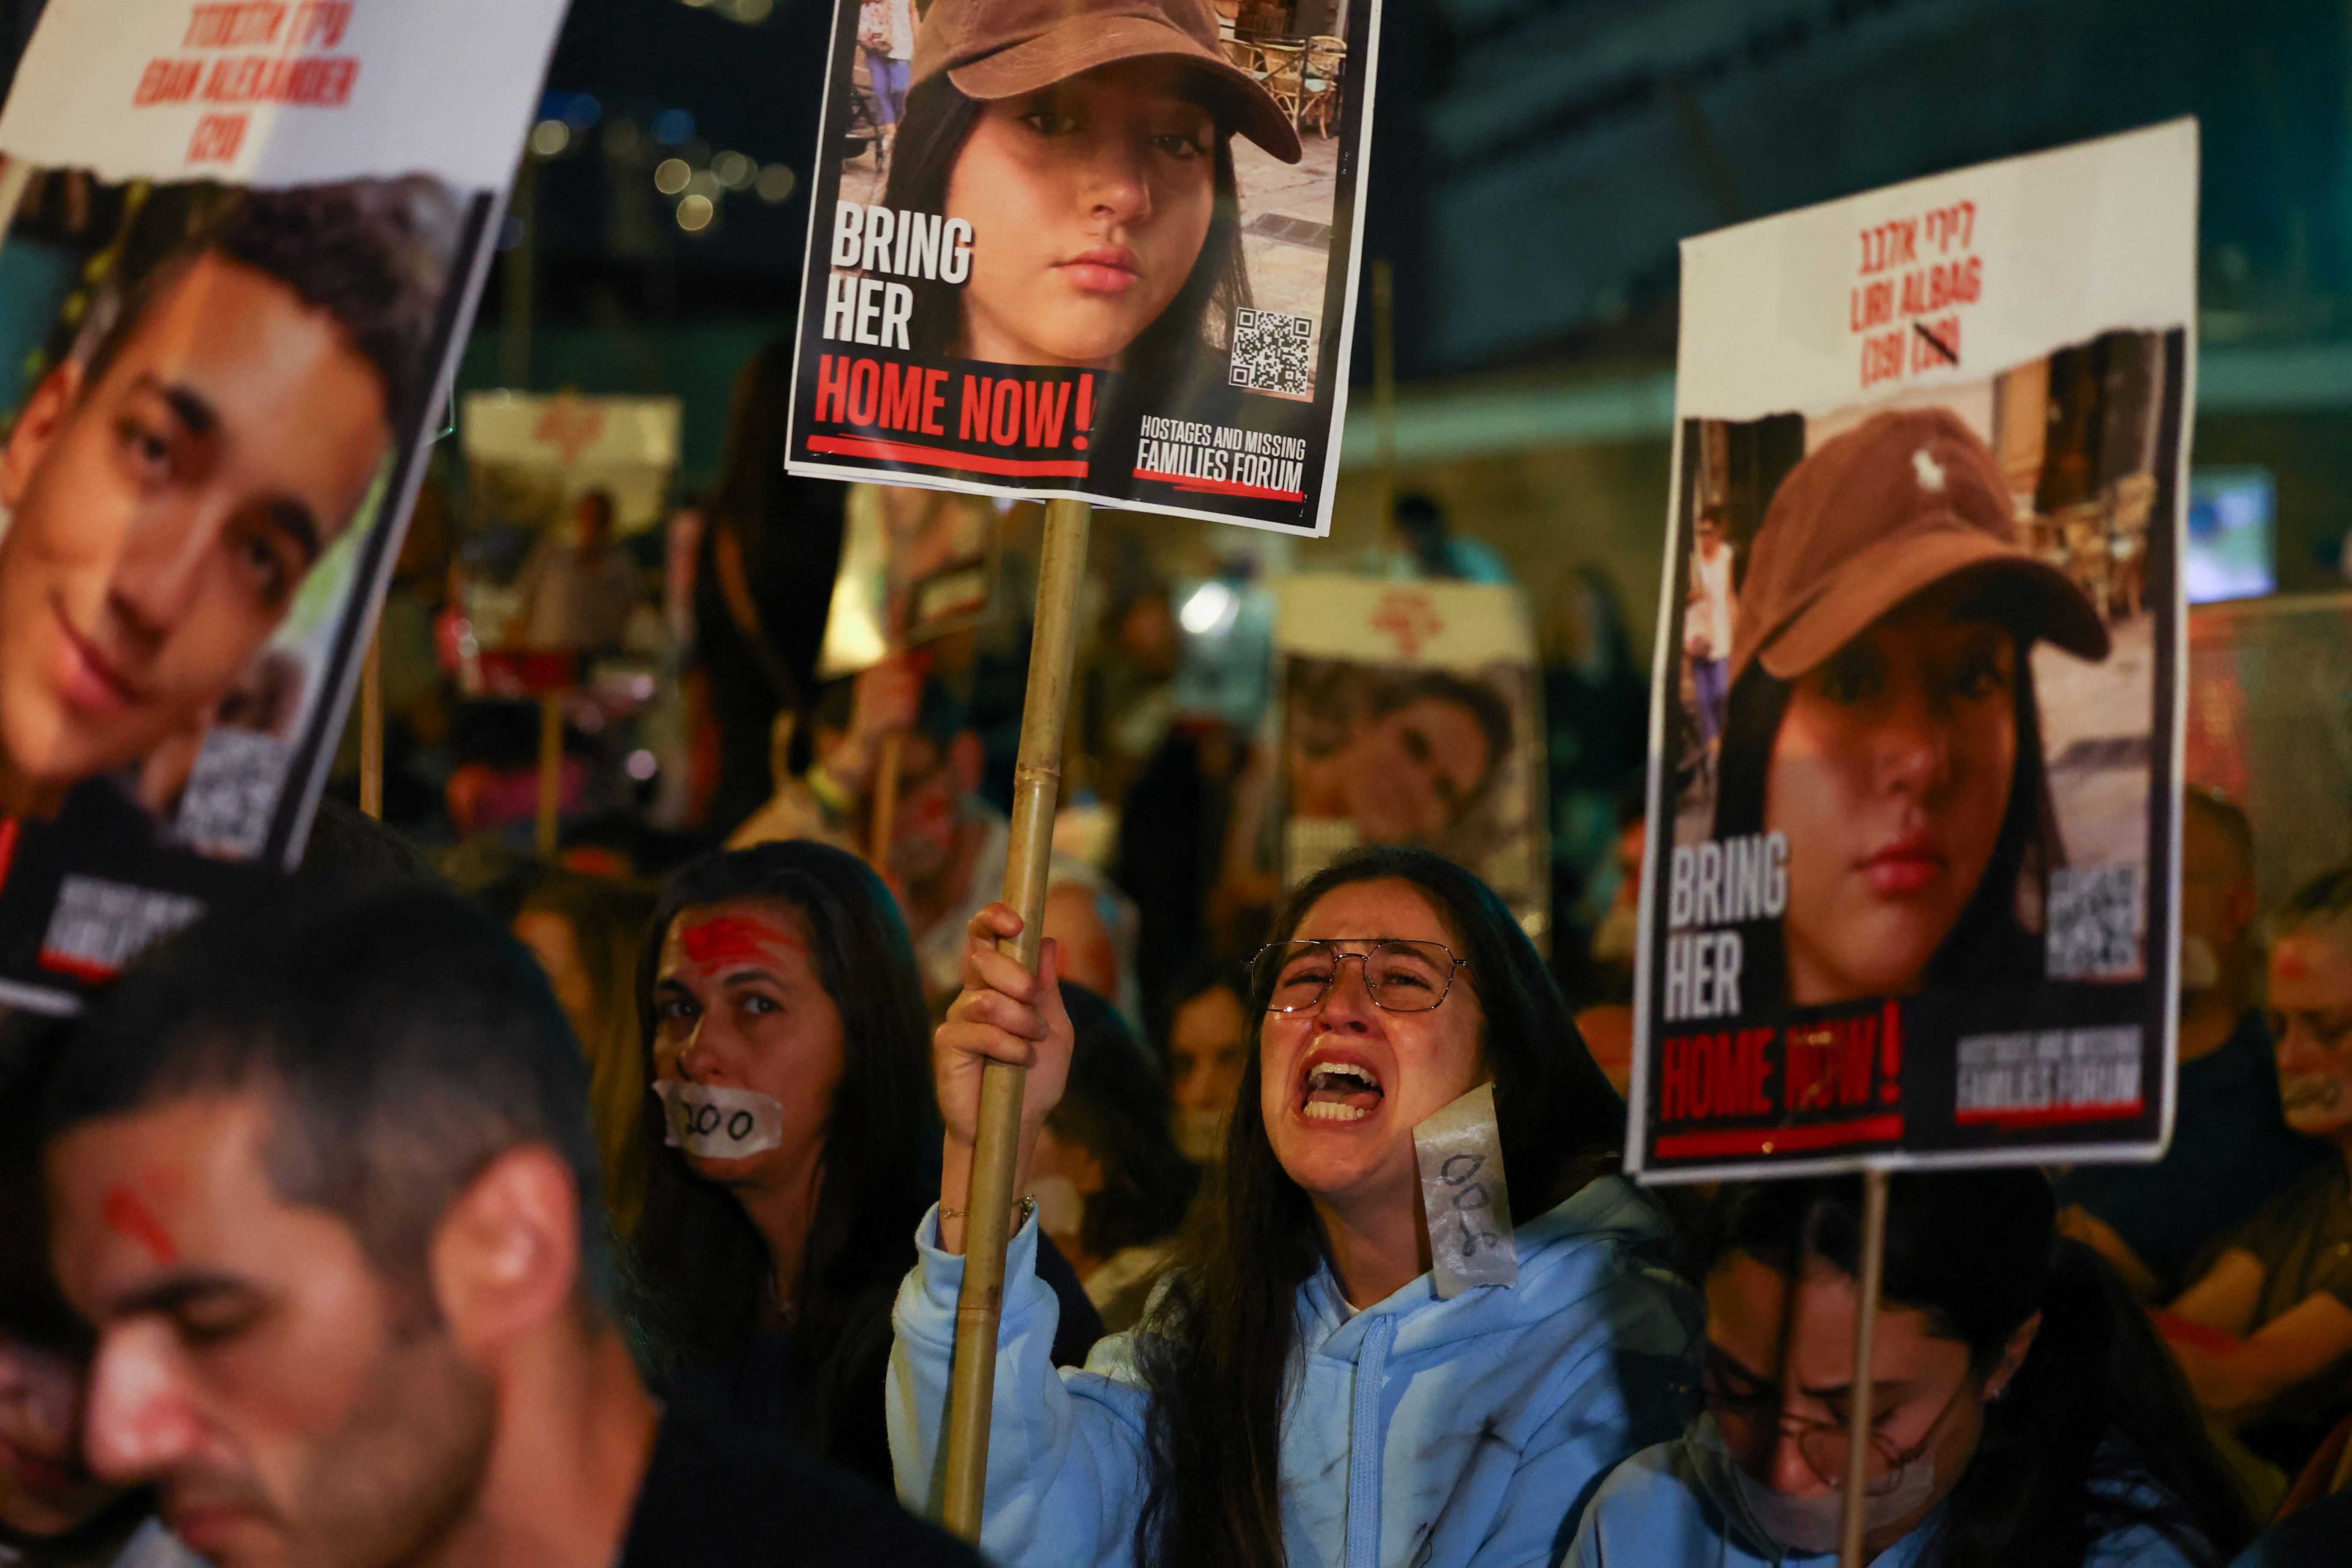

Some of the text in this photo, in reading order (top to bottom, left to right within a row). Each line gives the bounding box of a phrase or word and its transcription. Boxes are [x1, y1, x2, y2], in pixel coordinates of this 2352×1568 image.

[830, 200, 972, 284] BRING
[823, 274, 914, 350] HER
[1899, 257, 1983, 319] ALBAG
[814, 354, 1096, 451] HOME NOW!
[1141, 415, 1306, 461] HOSTAGES AND MISSING
[1136, 439, 1303, 494] FAMILIES FORUM
[1669, 830, 1789, 929] BRING
[1664, 930, 1743, 1022] HER
[1661, 999, 1901, 1121] HOME NOW!
